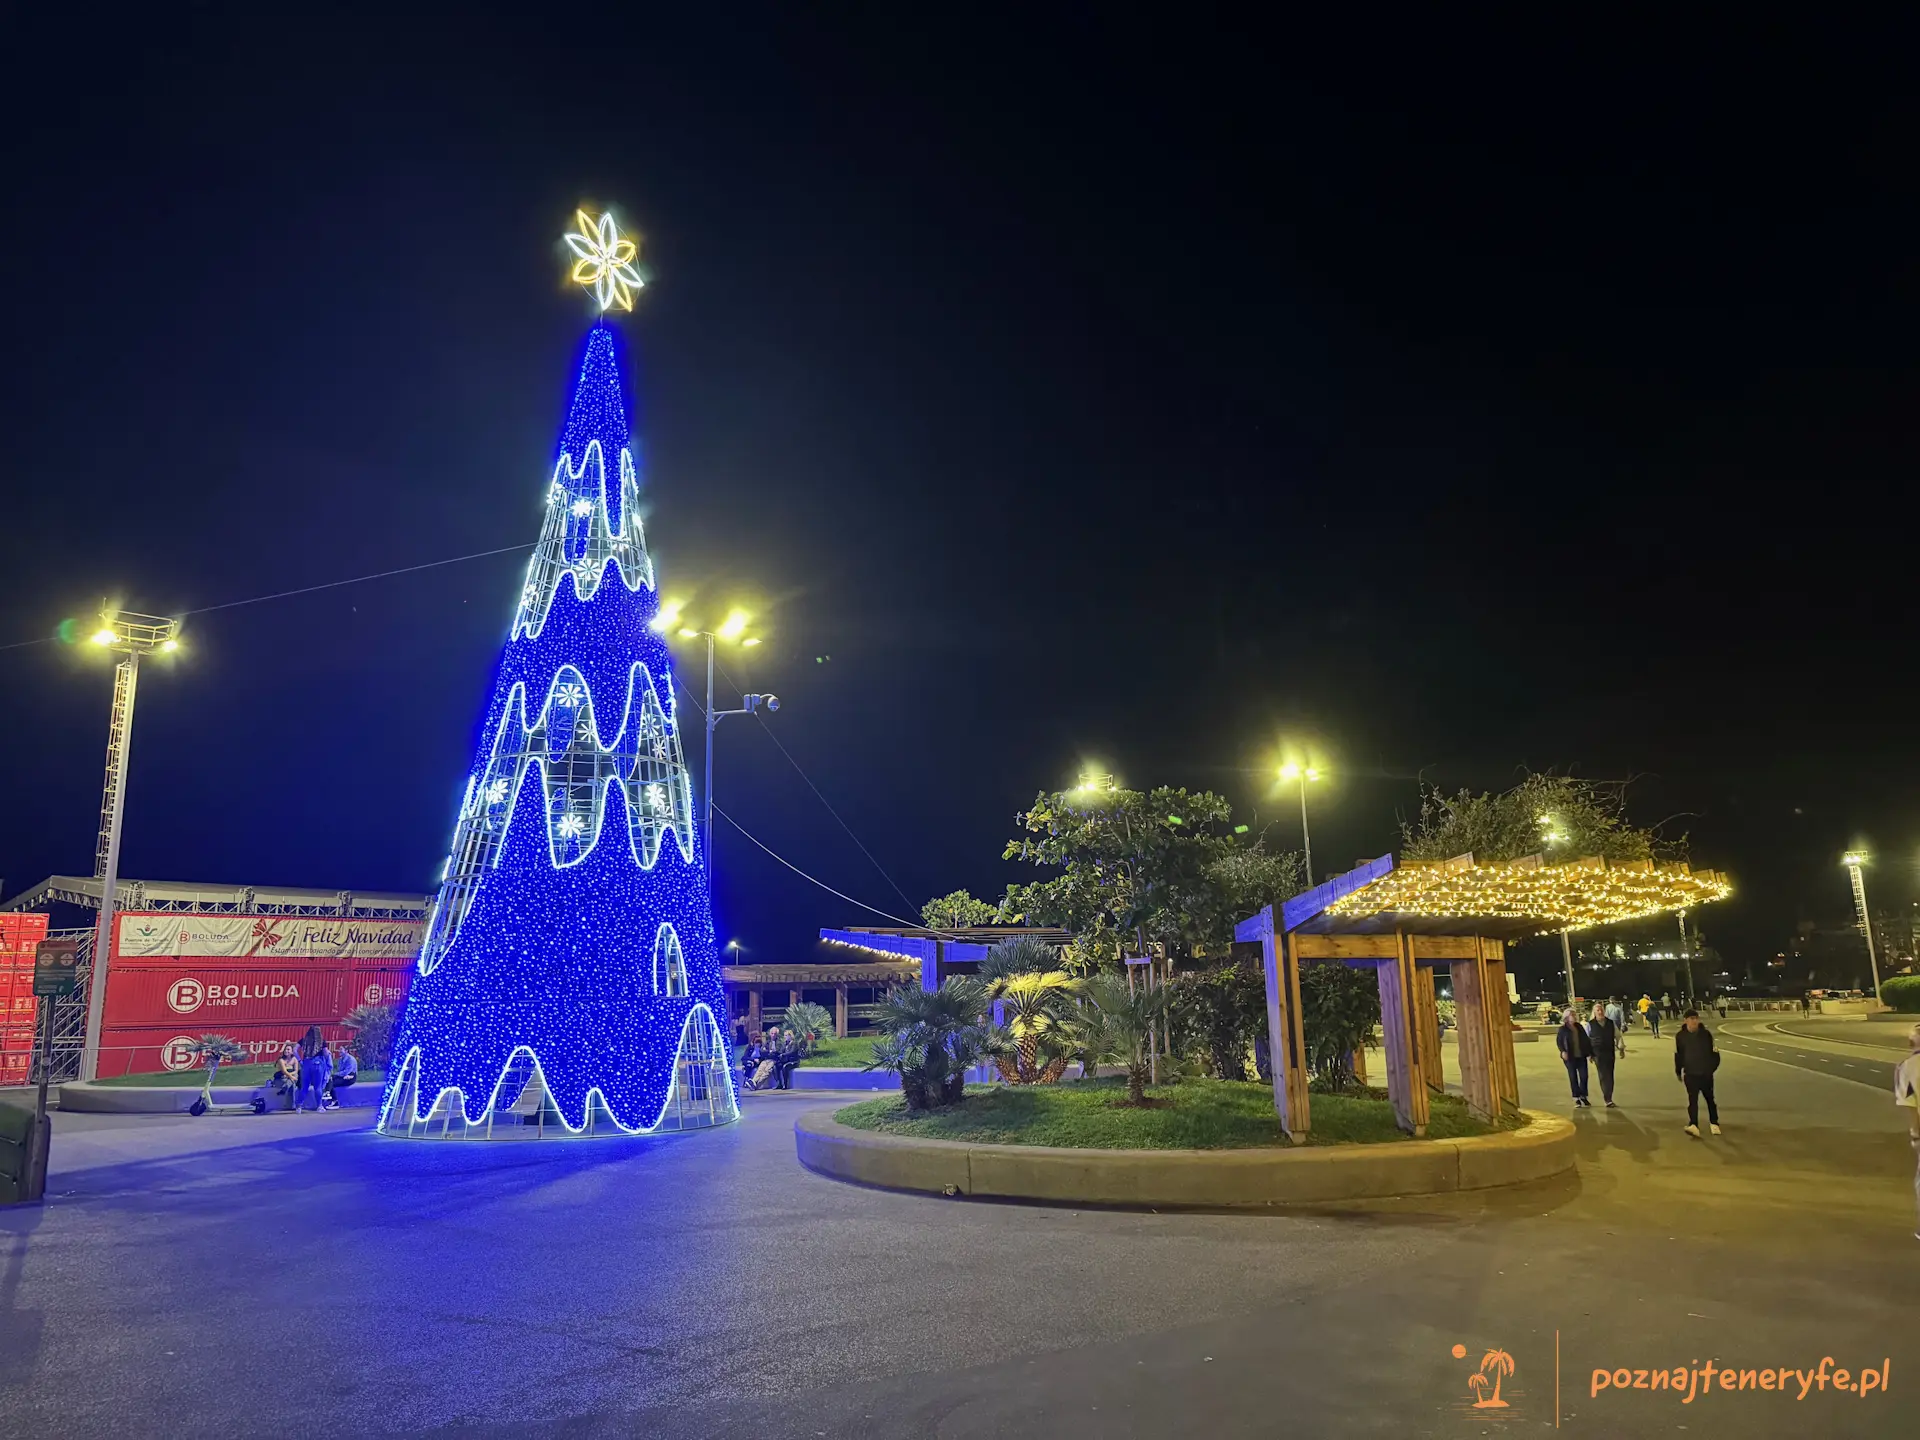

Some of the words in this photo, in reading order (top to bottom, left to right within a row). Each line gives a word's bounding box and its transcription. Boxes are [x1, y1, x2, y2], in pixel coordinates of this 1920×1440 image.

[303, 926, 341, 946] Feliz
[345, 928, 413, 944] Navidad
[207, 985, 300, 999] BOLUDA
[386, 987, 408, 996] BOL
